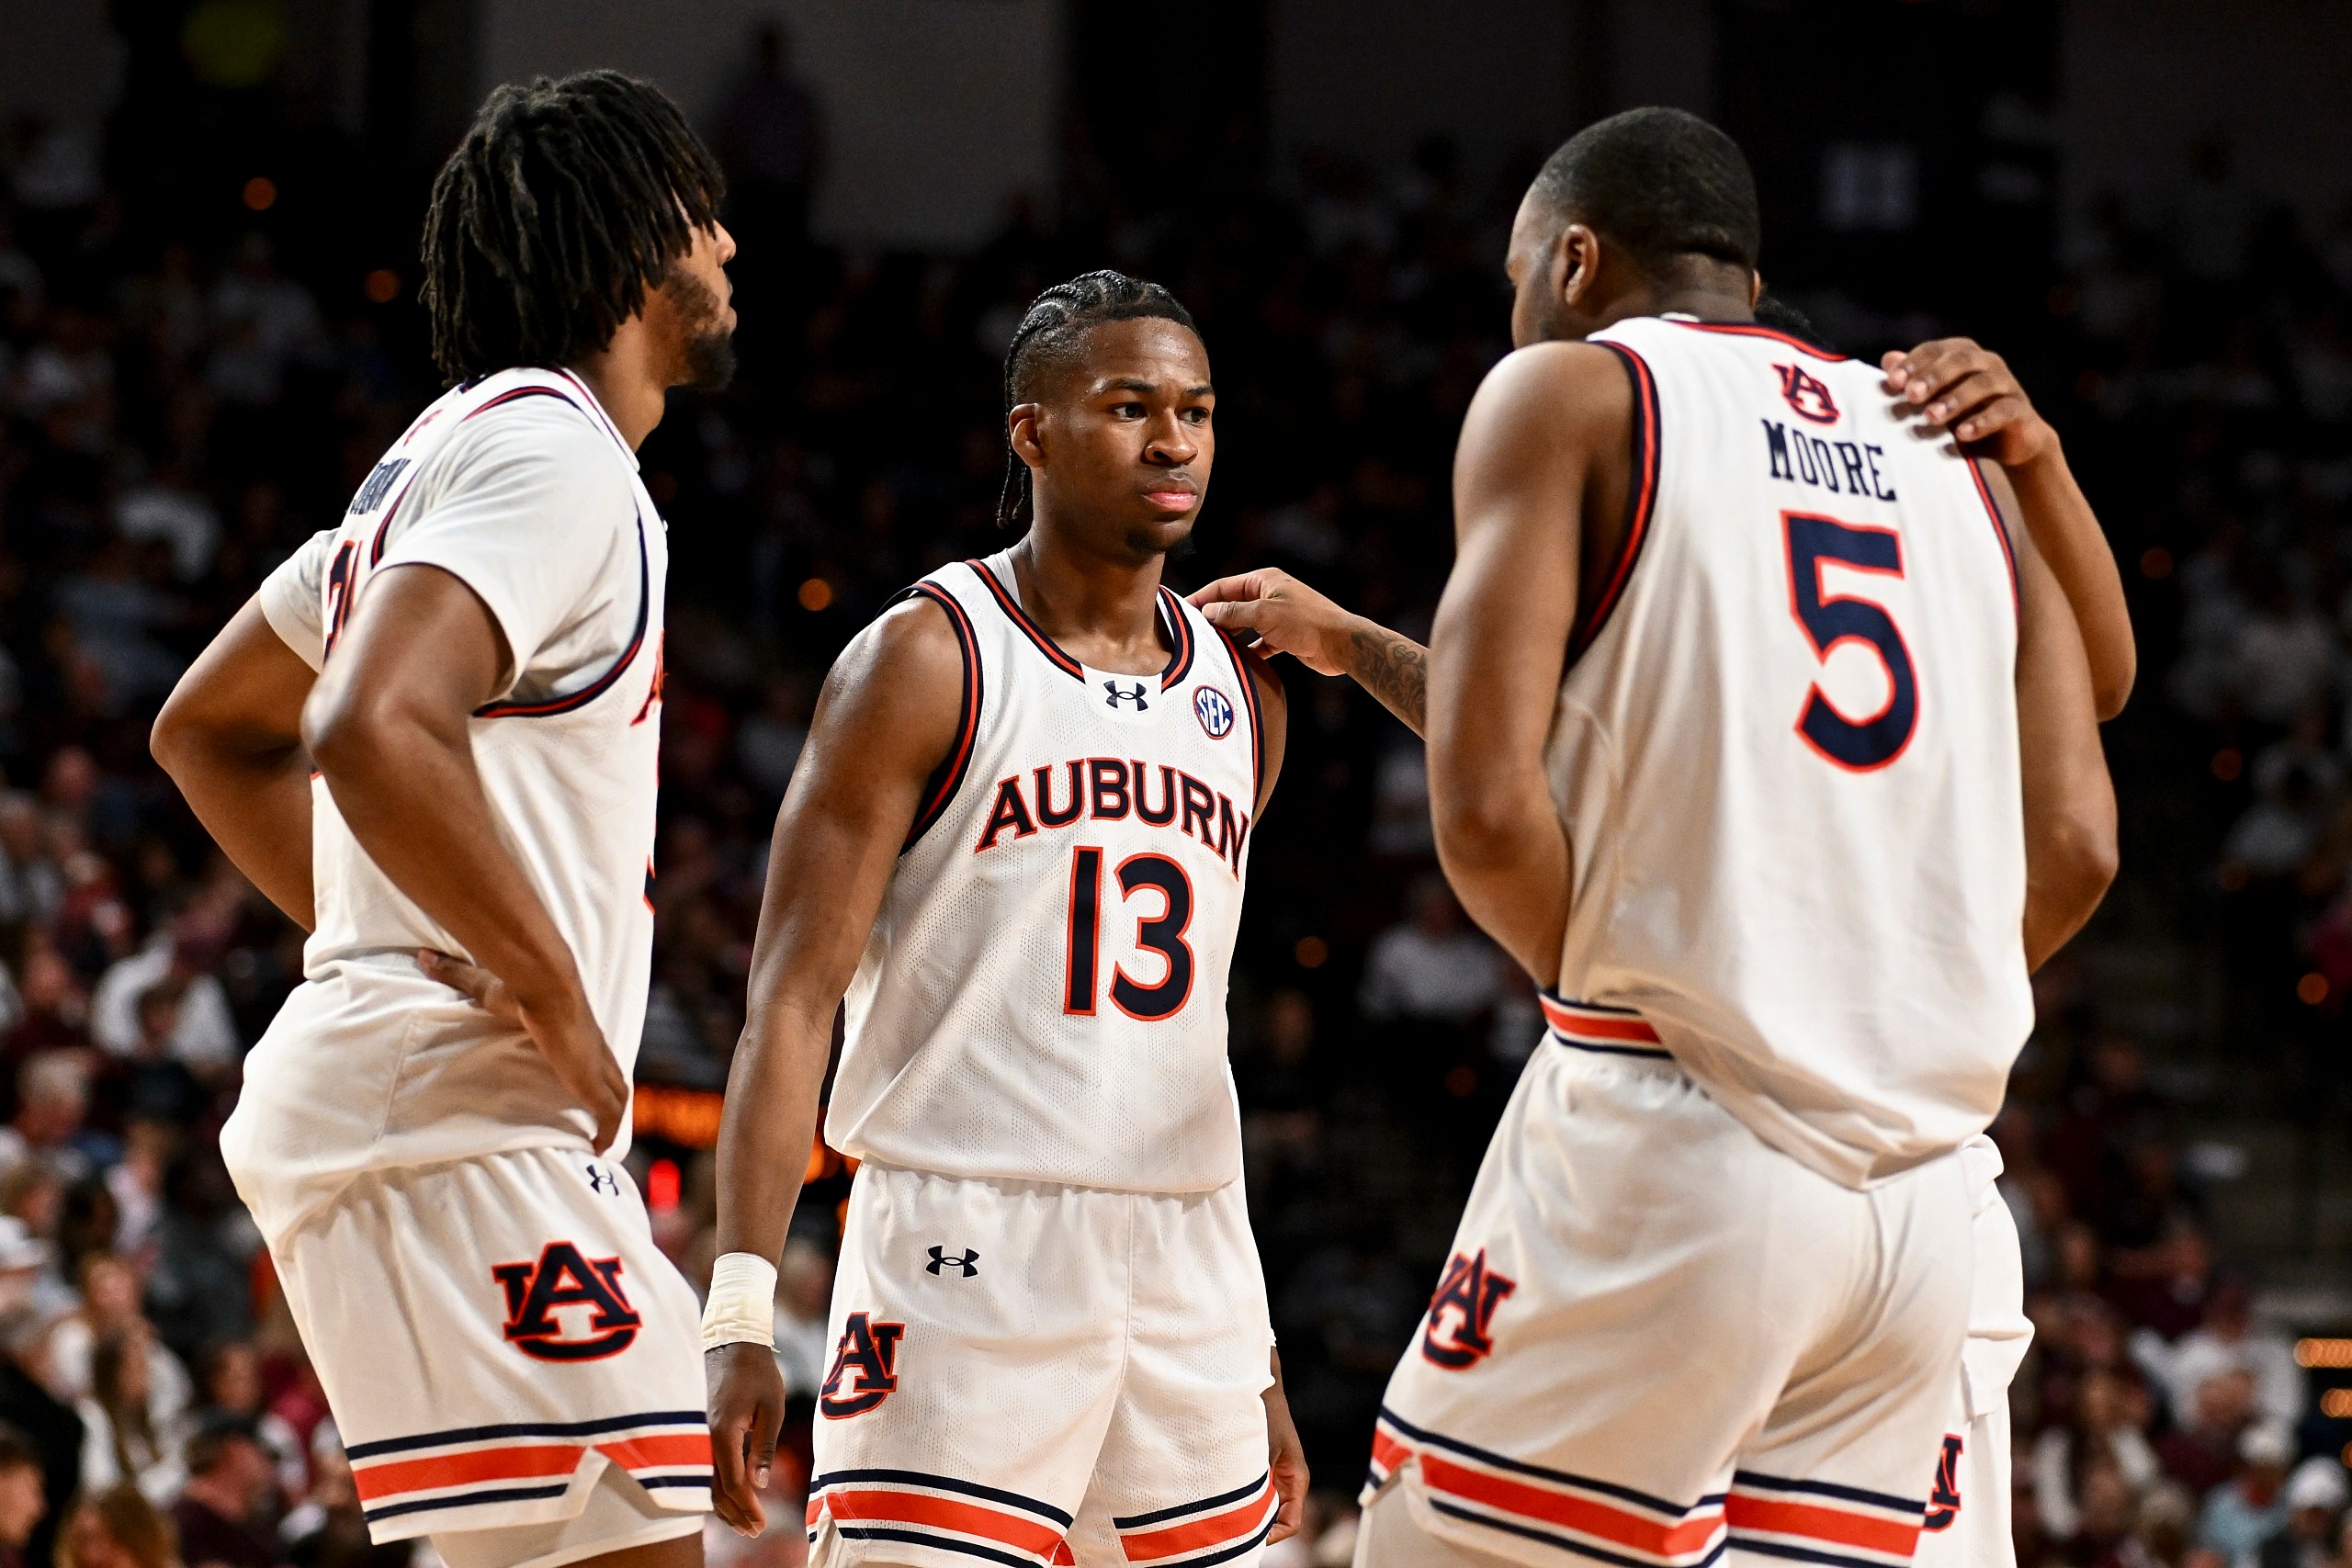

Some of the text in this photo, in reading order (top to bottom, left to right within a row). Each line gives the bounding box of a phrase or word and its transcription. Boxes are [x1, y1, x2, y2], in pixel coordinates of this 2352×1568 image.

[1761, 418, 1897, 502] MOORE
[1780, 510, 1920, 773] 5
[1195, 687, 1232, 737] SEC
[976, 757, 1250, 881] AUBURN
[1064, 845, 1194, 1021] 13
